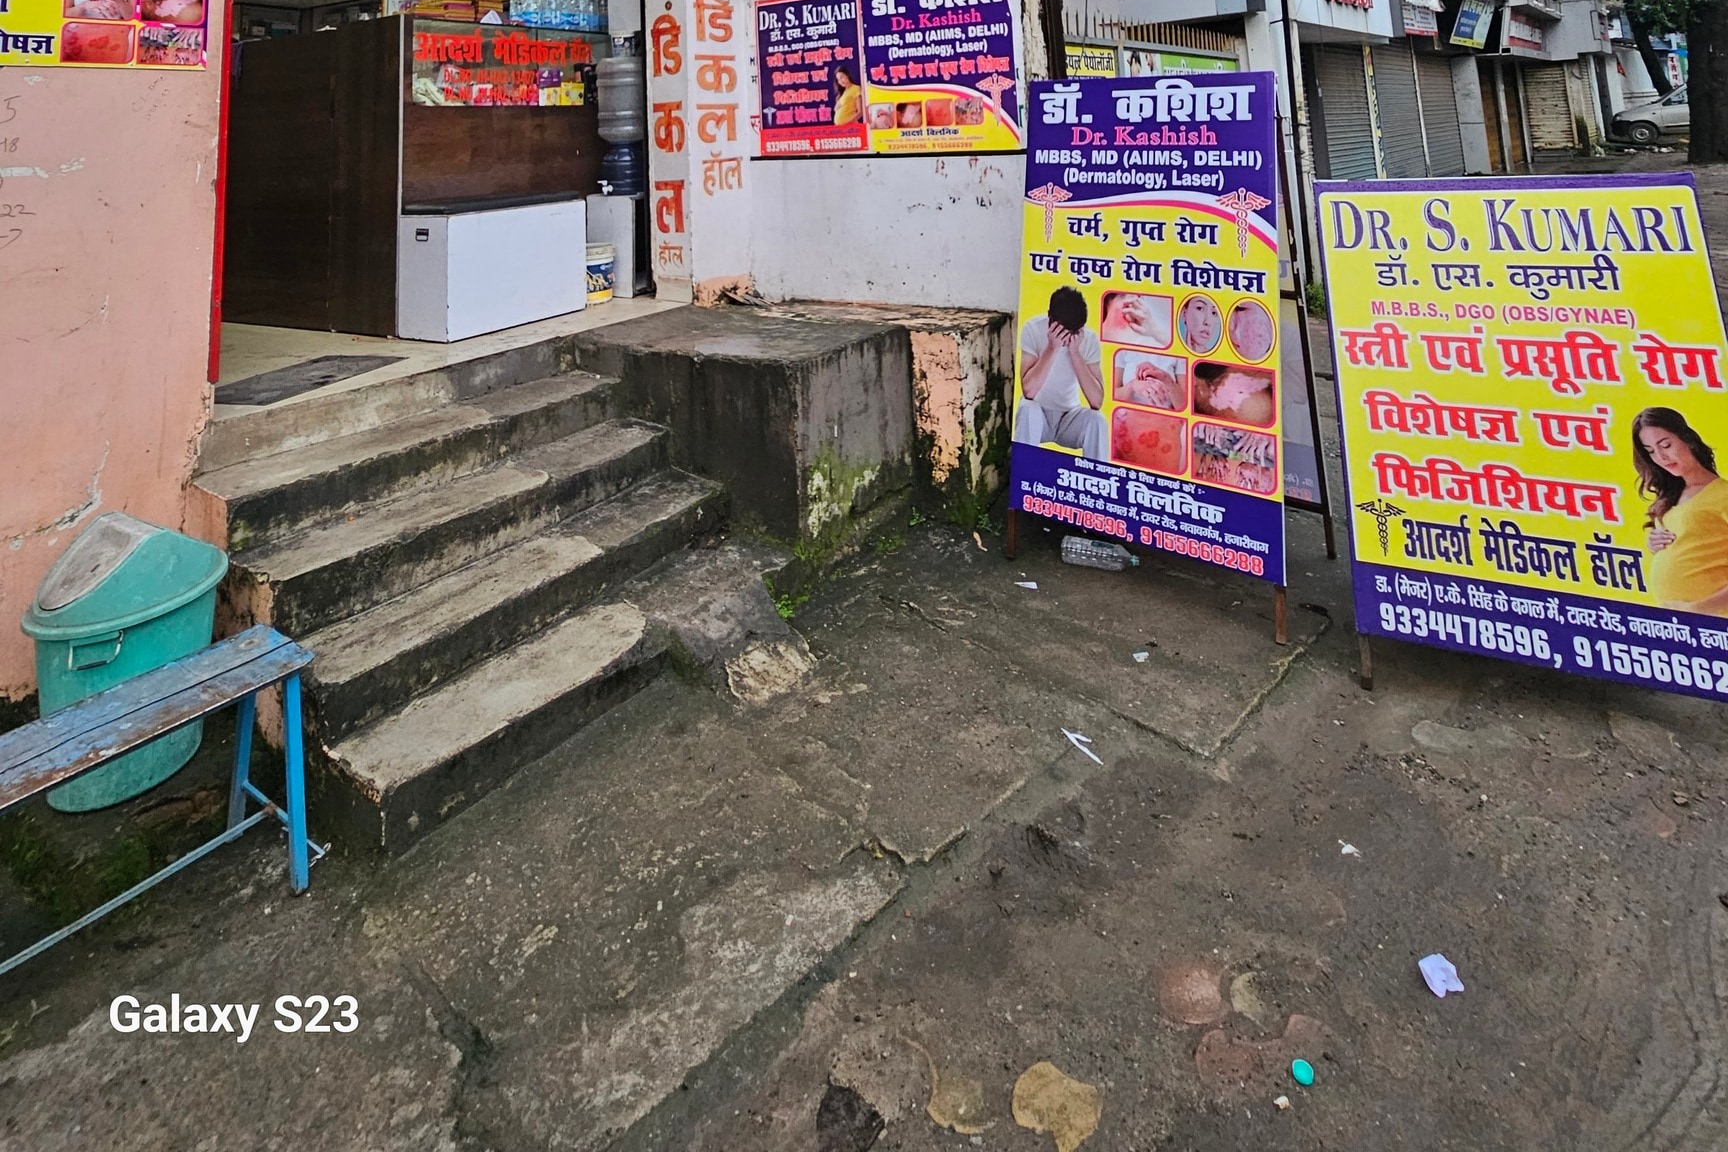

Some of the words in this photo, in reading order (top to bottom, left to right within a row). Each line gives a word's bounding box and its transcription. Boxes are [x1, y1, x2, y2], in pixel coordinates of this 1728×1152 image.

[759, 11, 781, 31] DR.
[785, 6, 798, 27] S.
[802, 2, 856, 25] KUMARI
[868, 33, 903, 47] MBBS,
[905, 31, 923, 44] MD
[925, 27, 965, 45] (AIIMS,
[967, 22, 1008, 38] DELHI)
[891, 16, 915, 31] Dr.
[918, 8, 982, 29] Kashish
[413, 27, 485, 63] आदर्श
[491, 30, 568, 66] मेडिकल
[888, 44, 954, 61] (Dermatology,
[956, 39, 988, 53] Laser)
[1040, 83, 1093, 124] डॉ.
[1112, 78, 1255, 123] कशिश
[1071, 126, 1107, 146] Dr.
[1114, 124, 1217, 146] Kashish
[1035, 150, 1086, 167] MBBS,
[1092, 150, 1118, 165] MD
[1123, 149, 1188, 168] (AIIMS,
[1194, 150, 1262, 170] DELHI)
[1063, 168, 1167, 189] (Dermatology,
[1172, 170, 1224, 191] Laser)
[1067, 212, 1109, 242] चर्म,
[1120, 219, 1165, 246] गुप्त
[1174, 217, 1218, 245] रोग
[1330, 200, 1408, 250] DR.
[1425, 198, 1470, 252] S.
[1483, 198, 1694, 253] KUMARI
[1029, 250, 1062, 274] एवं
[1068, 256, 1114, 284] कुष्ठ
[1121, 256, 1162, 284] रोग
[1171, 259, 1266, 294] विशेषज्ञ
[1375, 254, 1419, 286] डॉ.
[1431, 262, 1494, 290] एस.
[1506, 253, 1620, 300] कुमारी
[1371, 300, 1450, 322] M.B.B.S.,
[1455, 304, 1495, 319] DGO
[1502, 305, 1636, 329] (OBS/GYNAE)
[1340, 322, 1409, 368] स्त्री
[1420, 325, 1485, 374] एवं
[1496, 330, 1622, 396] प्रसूति
[1632, 333, 1724, 389] रोग
[1363, 390, 1520, 444] विशेषज्ञ
[1532, 407, 1610, 452] एवं
[1057, 466, 1121, 500] आदर्श
[1125, 480, 1226, 525] क्लिनिक
[1371, 452, 1620, 522] फिजिशियन
[1022, 494, 1134, 543] 9334478596,
[1140, 526, 1264, 576] 9155666288
[1401, 515, 1473, 567] आदर्श
[1480, 517, 1580, 583] मेडिकल
[1585, 532, 1647, 593] हॉल
[1395, 572, 1432, 605] (मेजर)
[1467, 585, 1493, 610] सिंह
[1493, 590, 1508, 612] के
[1510, 596, 1545, 619] बगल
[1565, 605, 1598, 628] टावर
[1598, 606, 1626, 635] रोड,
[1627, 616, 1697, 647] नवाबगंज,
[1380, 603, 1562, 669] 9334478596,
